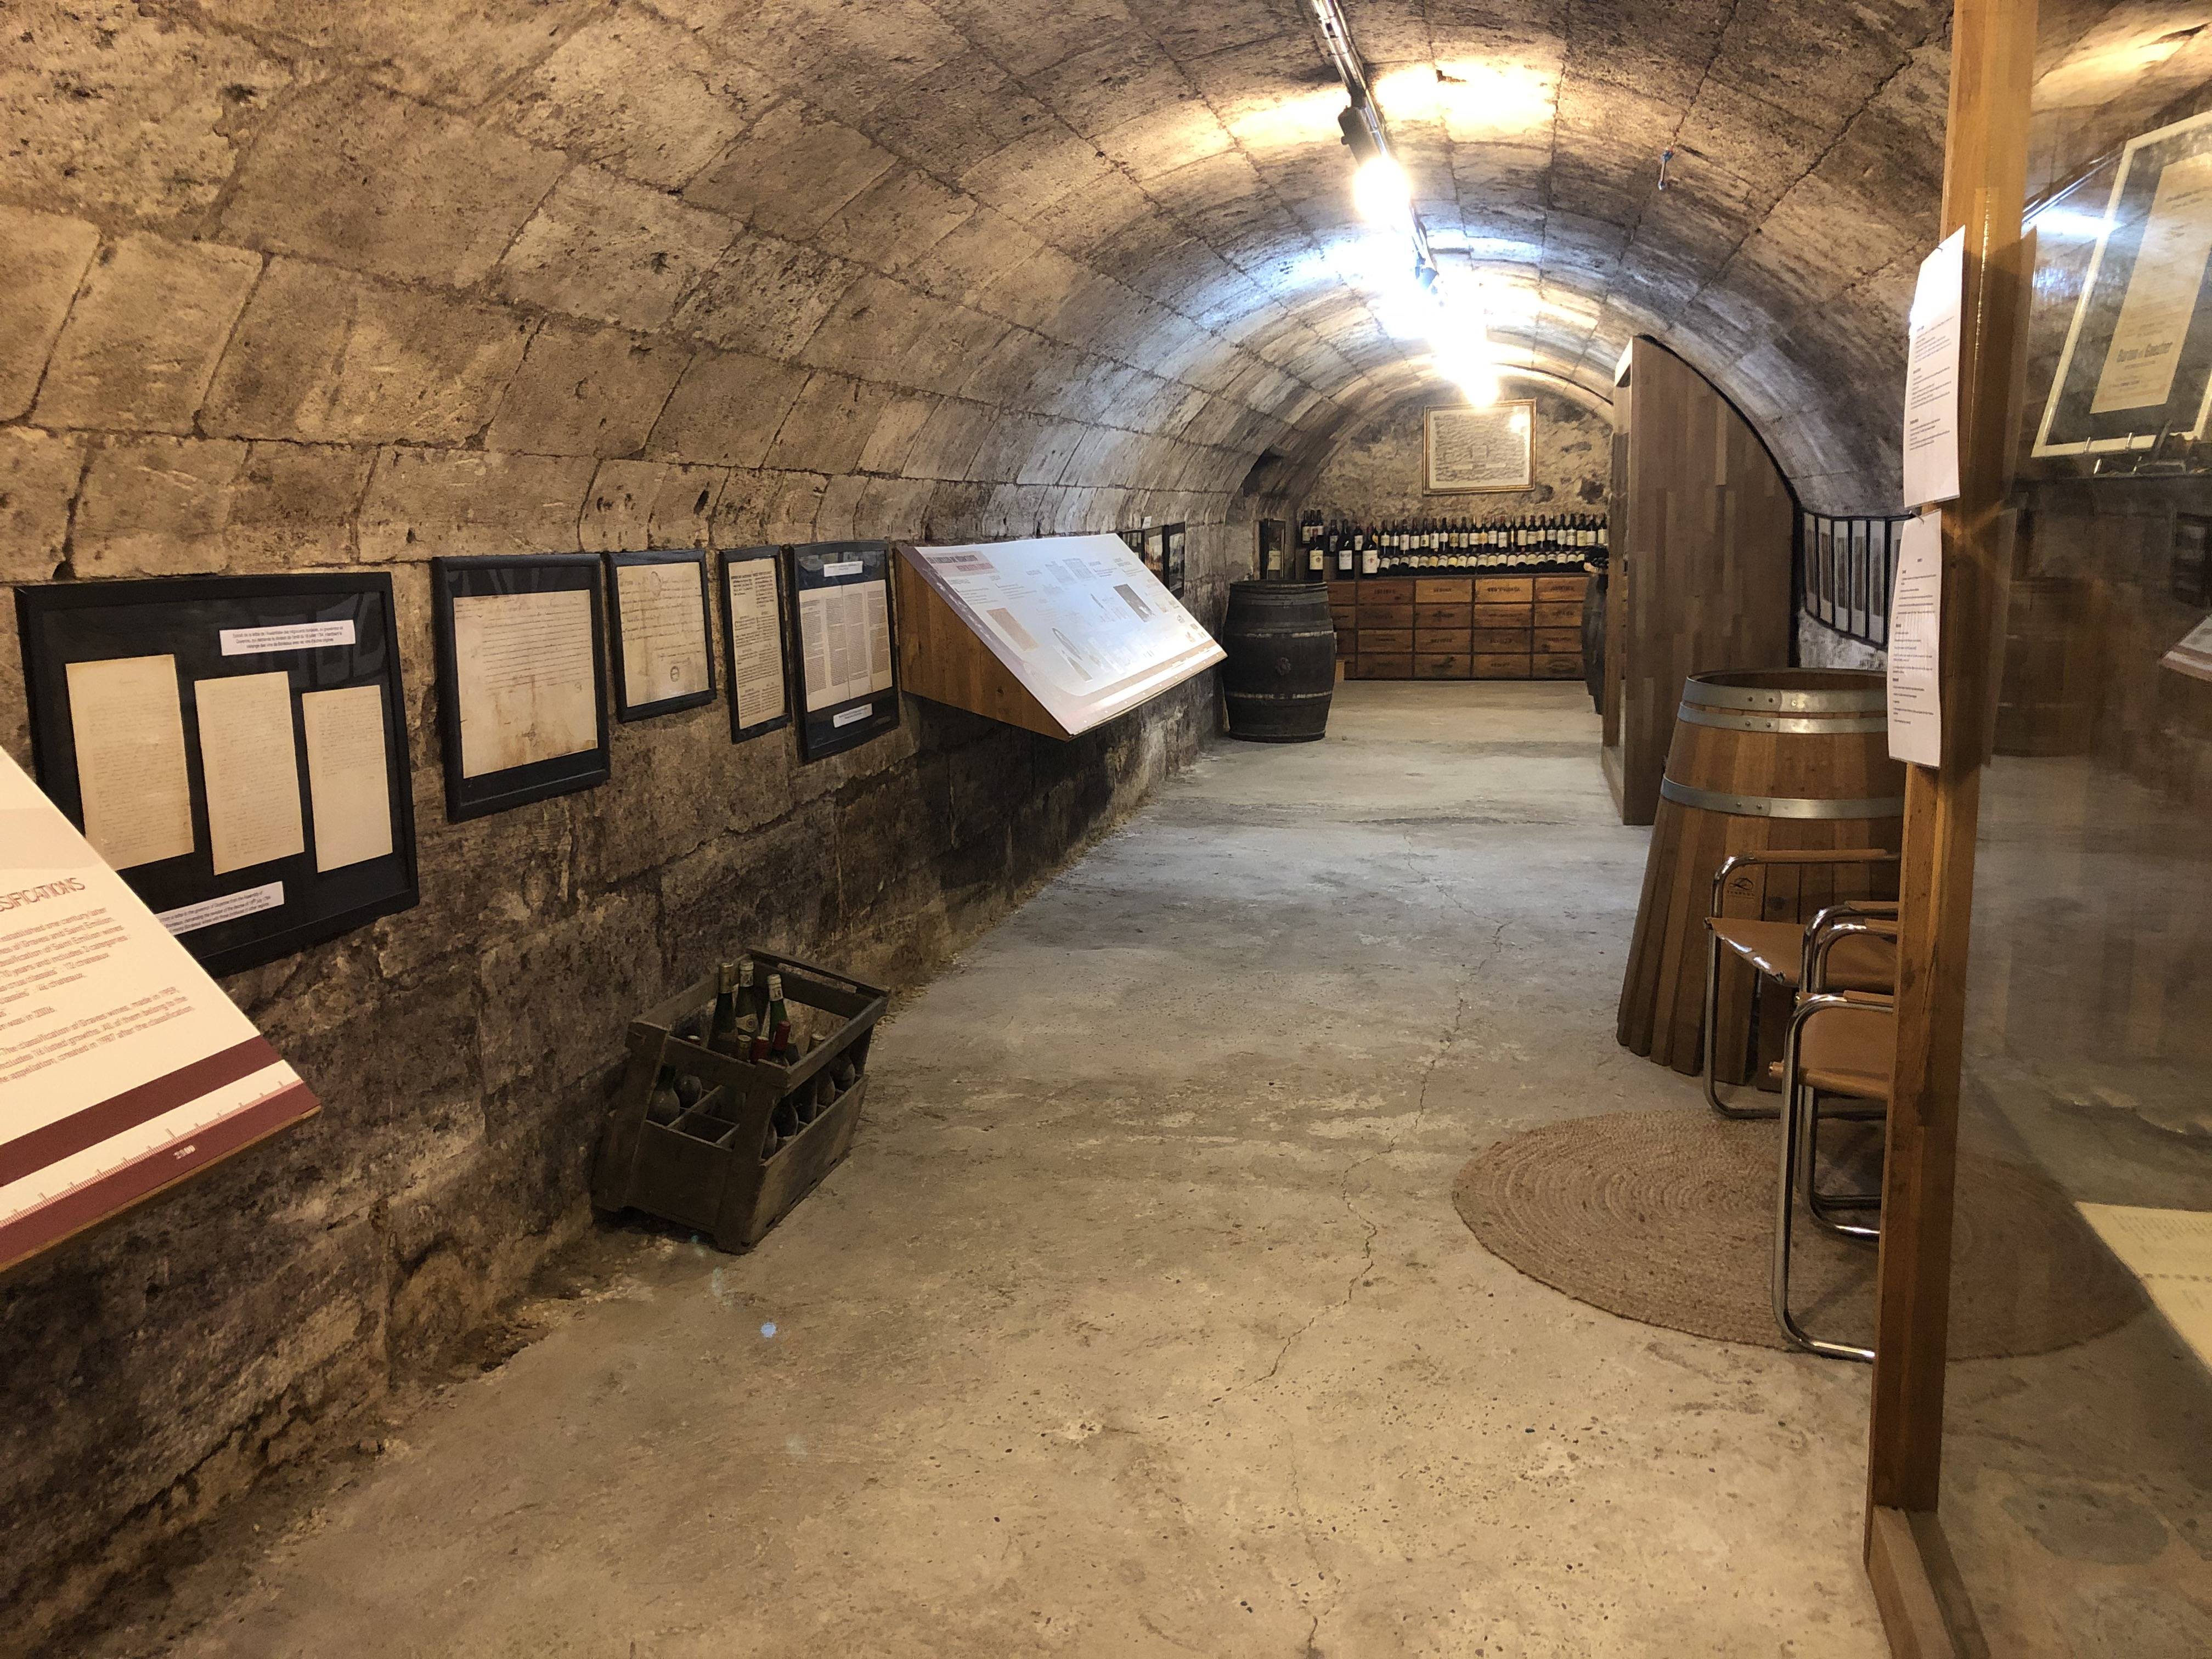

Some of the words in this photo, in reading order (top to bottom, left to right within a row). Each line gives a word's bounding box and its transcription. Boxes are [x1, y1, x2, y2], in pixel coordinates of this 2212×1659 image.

[60, 913, 89, 925] century
[20, 935, 50, 948] Graves
[50, 929, 66, 940] and
[64, 924, 86, 935] Saint
[43, 945, 54, 953] of
[52, 940, 72, 951] Saint
[12, 964, 36, 977] years
[36, 958, 52, 968] and
[52, 949, 84, 963] includes
[17, 1026, 71, 1049] classification
[70, 1021, 80, 1030] of
[78, 1013, 107, 1026] Graves
[131, 996, 153, 1007] made
[44, 1038, 69, 1053] listed
[101, 1022, 115, 1031] All
[114, 1018, 122, 1027] of
[121, 1013, 142, 1024] them
[141, 1003, 169, 1017] belong
[173, 996, 188, 1005] the
[116, 1028, 133, 1039] after
[133, 1022, 149, 1031] the
